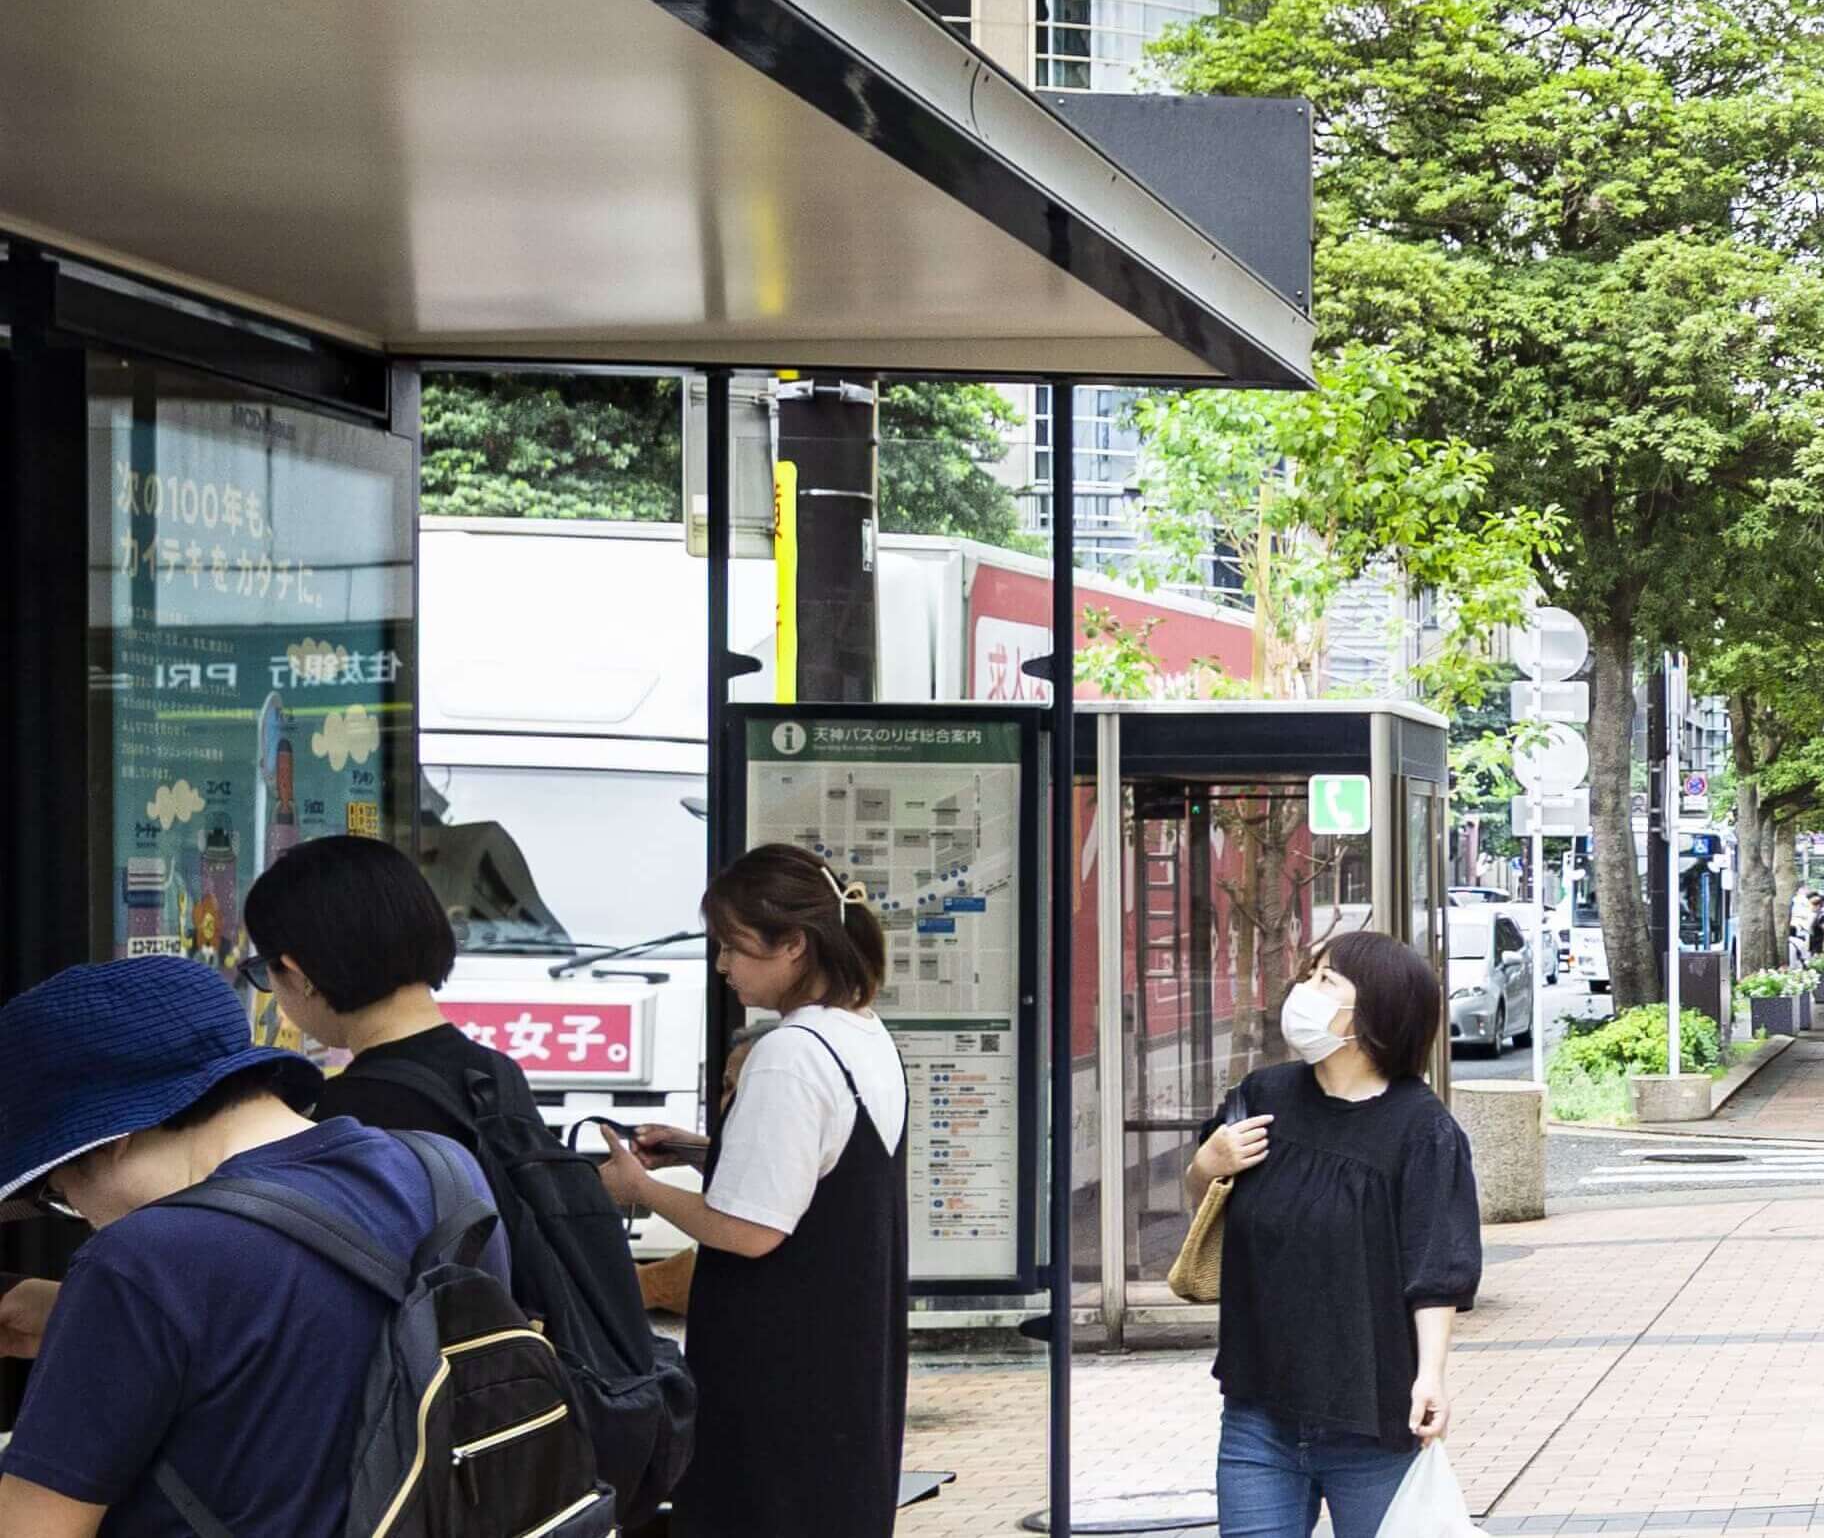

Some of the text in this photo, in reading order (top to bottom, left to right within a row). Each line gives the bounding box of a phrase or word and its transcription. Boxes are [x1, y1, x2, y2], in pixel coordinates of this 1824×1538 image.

[812, 726, 983, 746] 天神バスのりば総合案内
